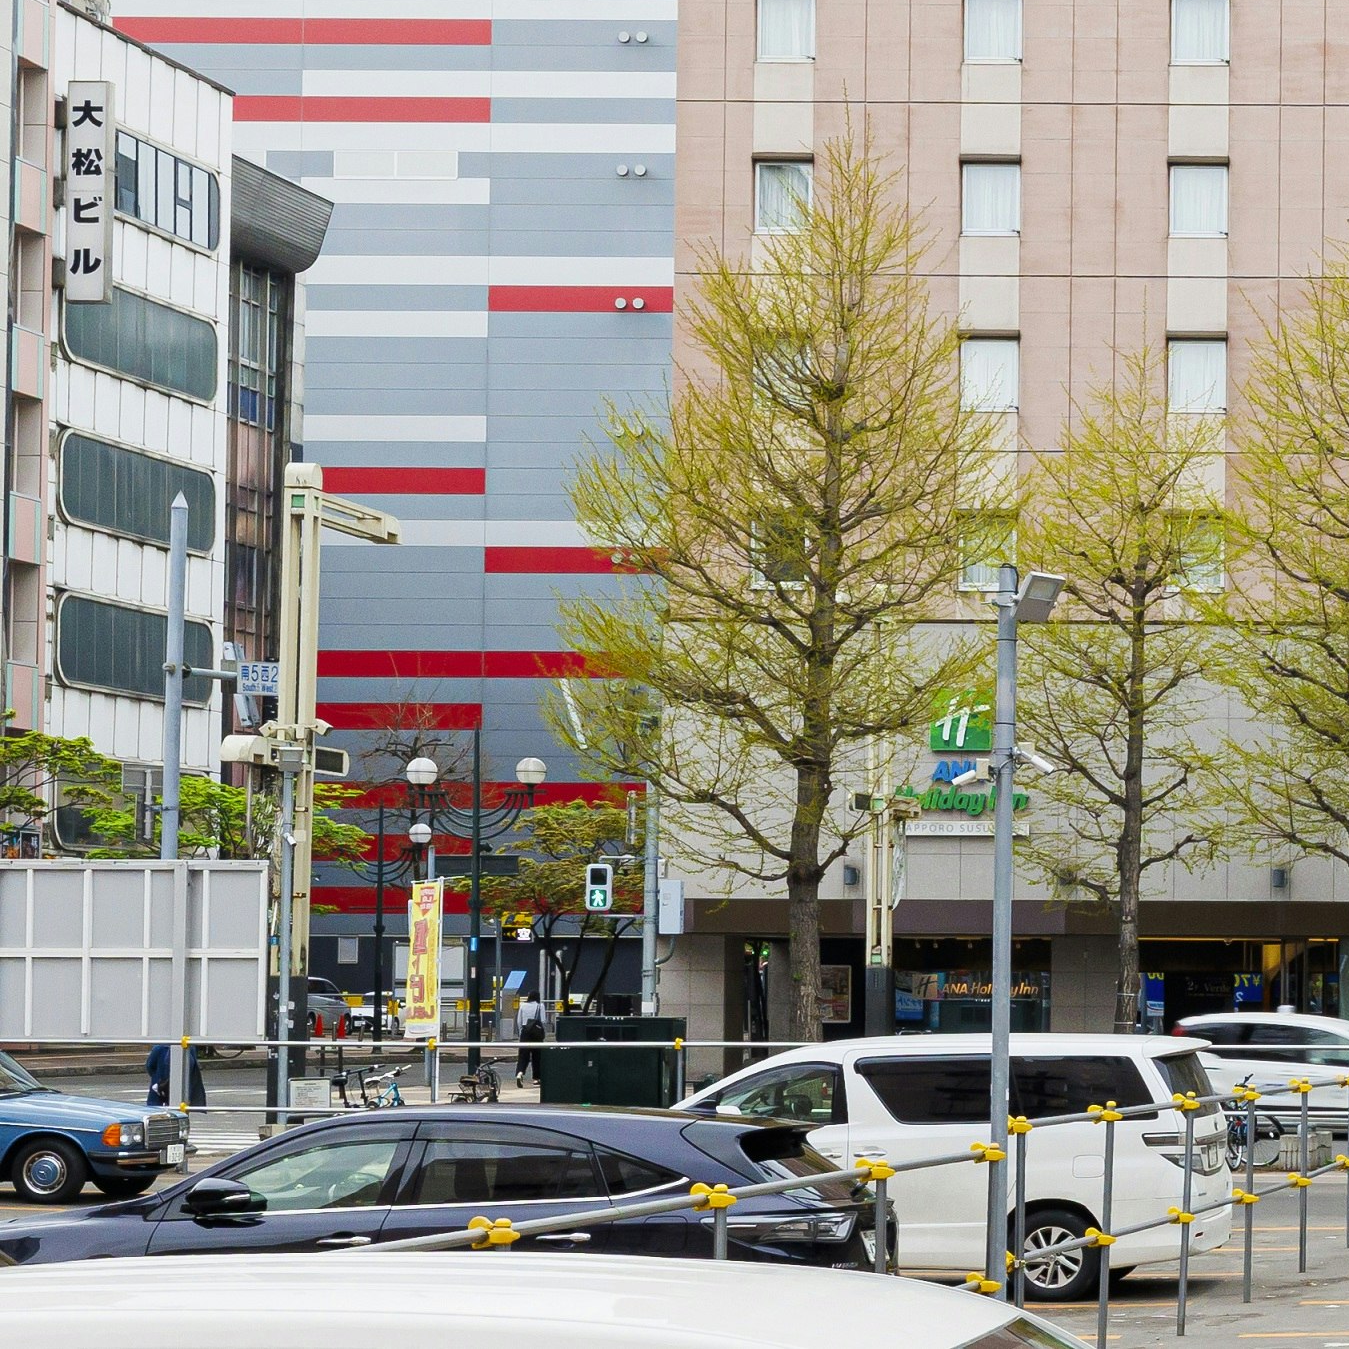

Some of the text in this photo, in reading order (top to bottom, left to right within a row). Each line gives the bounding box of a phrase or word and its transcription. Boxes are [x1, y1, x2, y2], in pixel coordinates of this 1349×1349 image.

[69, 100, 104, 275] 大松ビル
[241, 665, 279, 683] 南5西2
[932, 759, 986, 784] AN
[943, 980, 1039, 997] ANA Holy Inn
